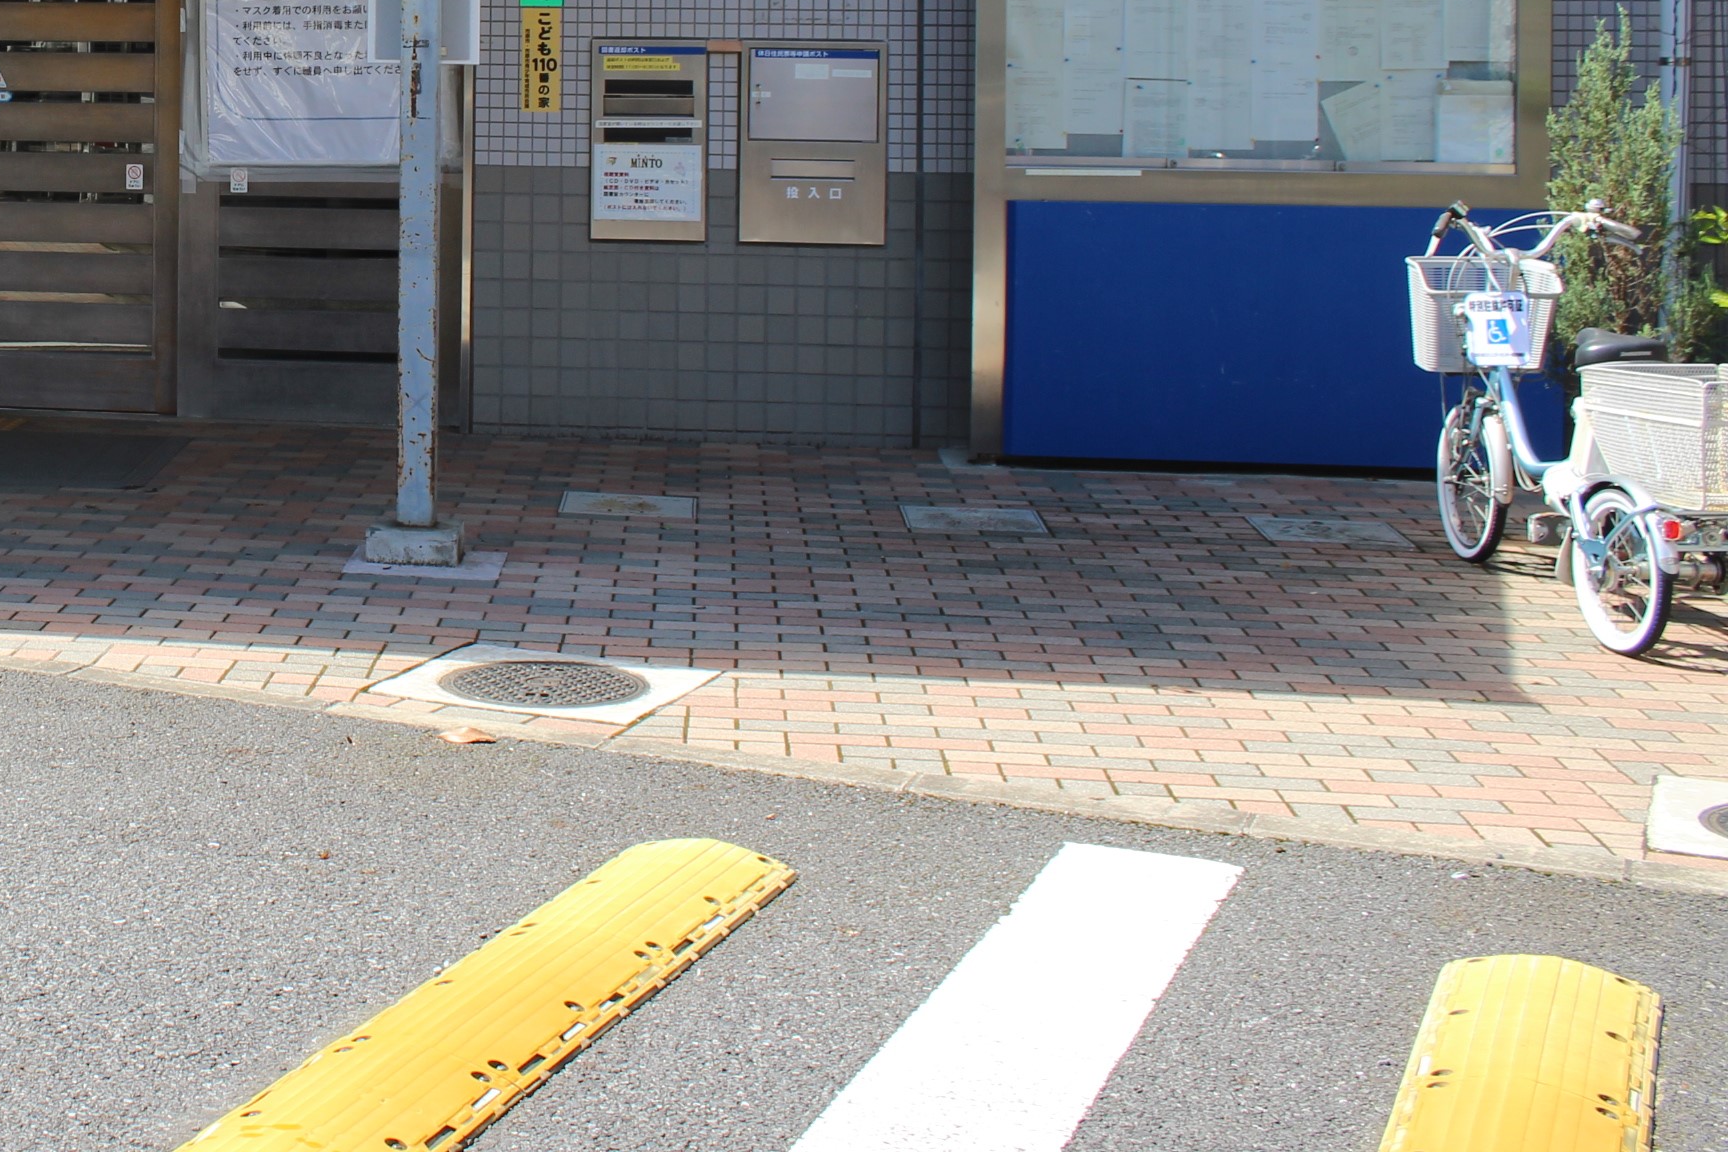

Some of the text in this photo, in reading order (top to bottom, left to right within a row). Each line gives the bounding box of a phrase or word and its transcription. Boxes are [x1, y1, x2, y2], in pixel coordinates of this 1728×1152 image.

[235, 51, 367, 61] ・利用中に体調不良となった
[532, 12, 557, 109] こども110番の家
[786, 186, 842, 200] 投入口
